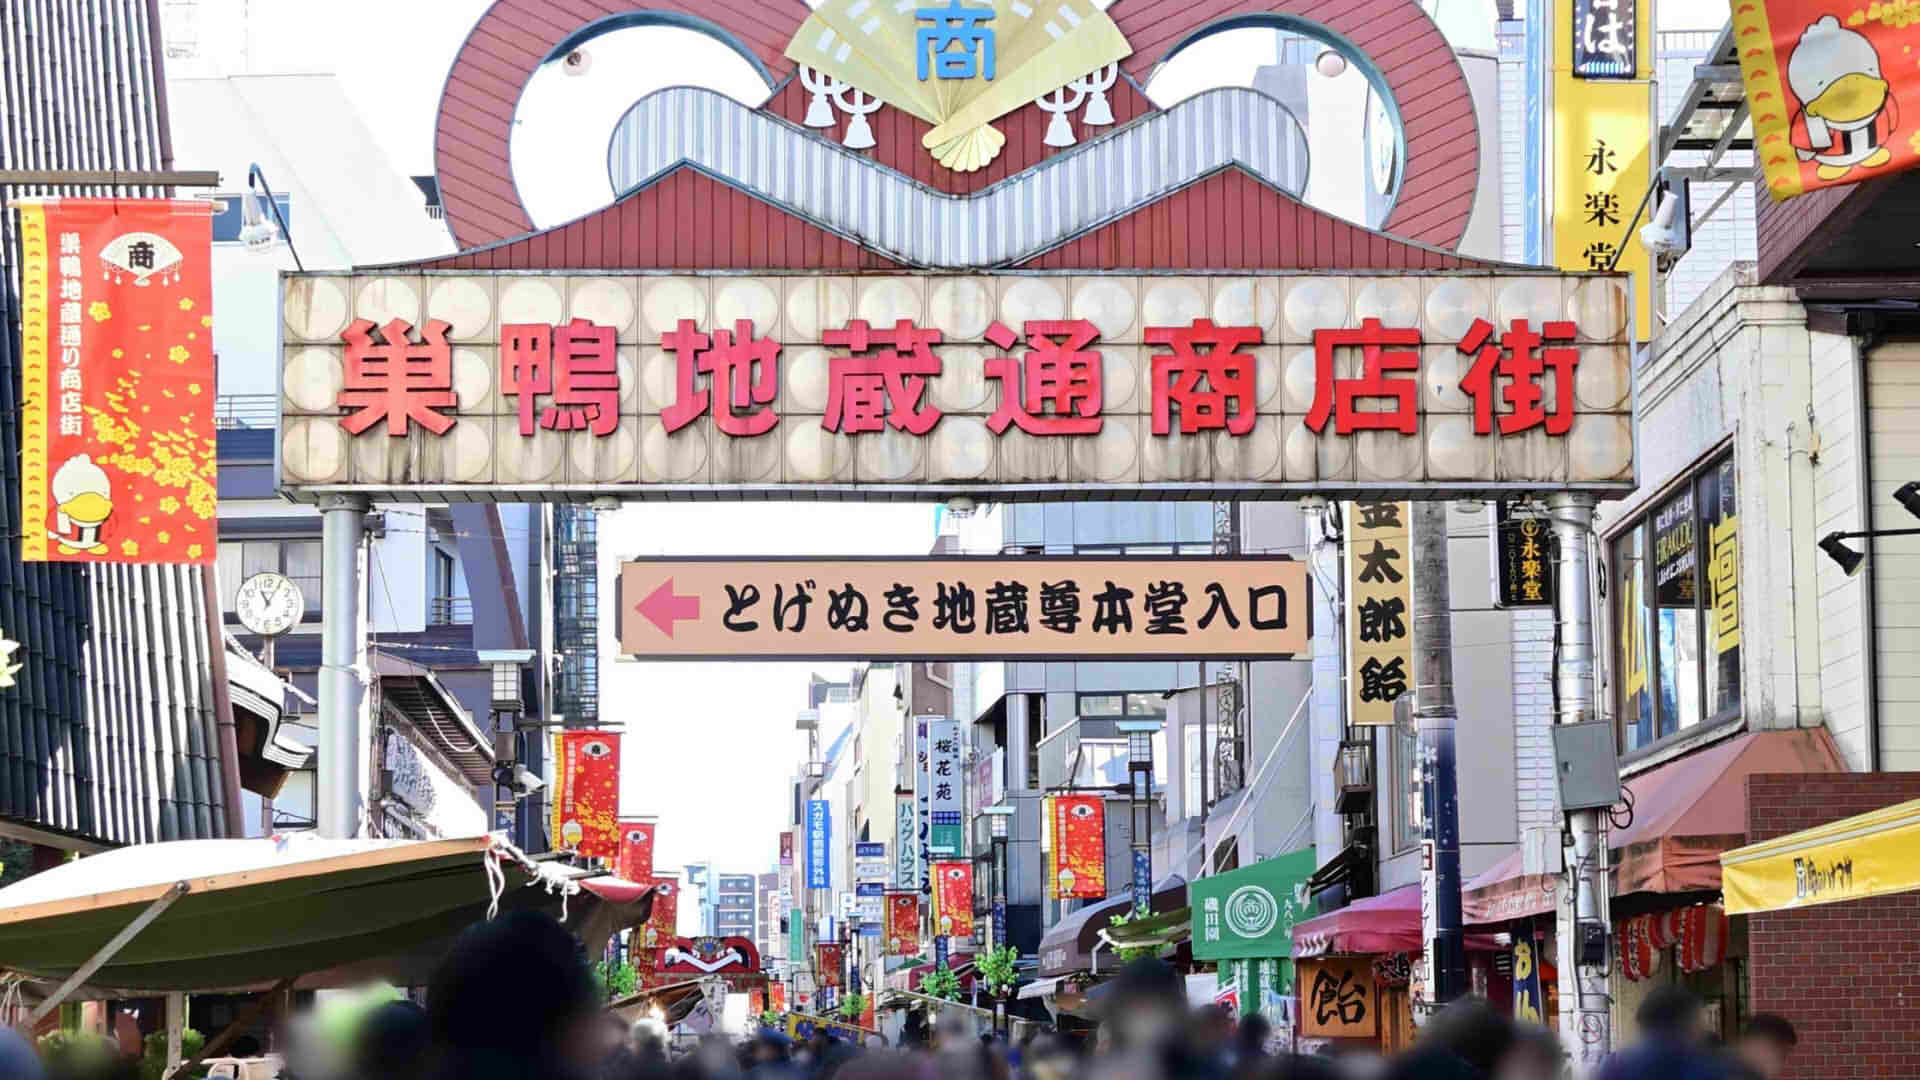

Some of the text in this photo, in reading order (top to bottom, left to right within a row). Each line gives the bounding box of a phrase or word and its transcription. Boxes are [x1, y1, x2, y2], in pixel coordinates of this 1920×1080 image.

[916, 0, 996, 81] 商
[1583, 139, 1620, 272] 永楽堂
[128, 241, 155, 270] 商
[59, 232, 83, 436] 巣鴨地蔵通り商店街
[337, 317, 1581, 438] 巣鴨地蔵通商店街
[721, 579, 1288, 635] とげぬき地蔵尊本堂入口
[935, 739, 953, 801] 桜花苑
[1311, 967, 1367, 1027] 飴
